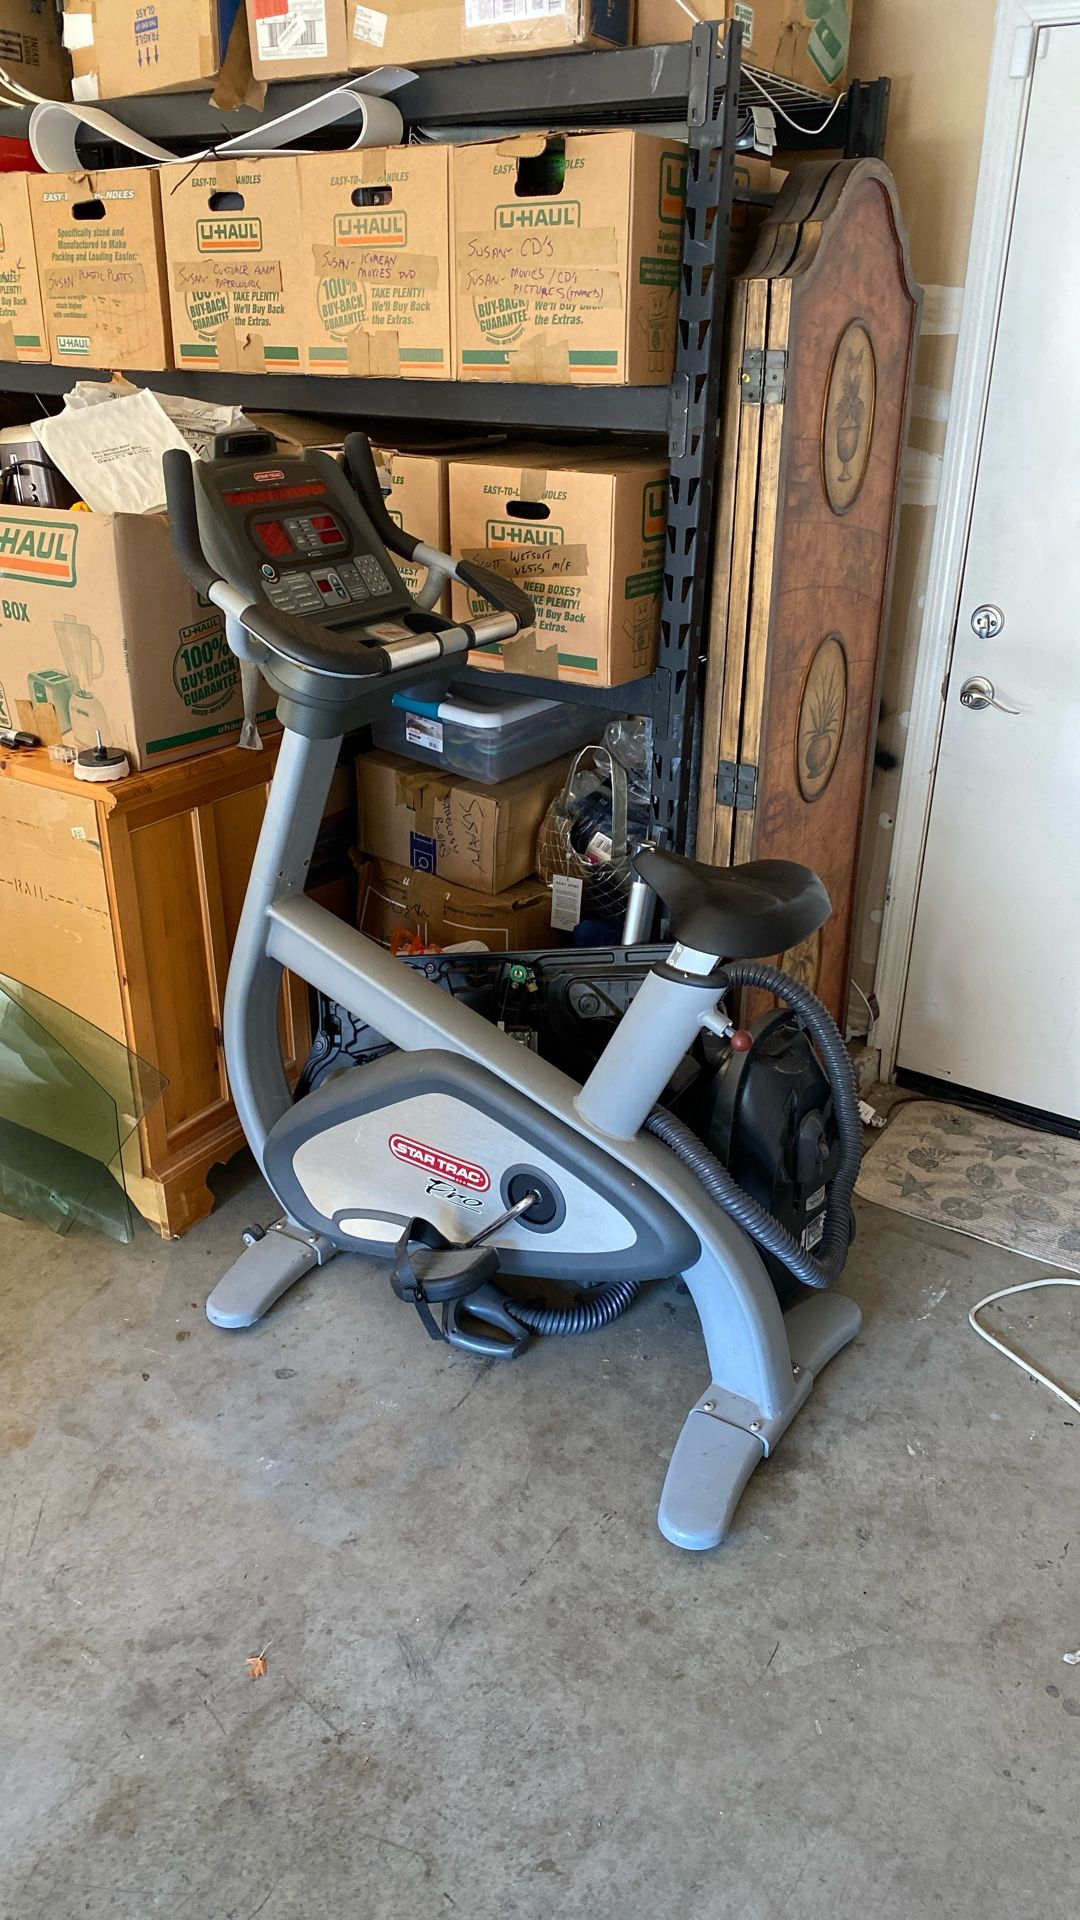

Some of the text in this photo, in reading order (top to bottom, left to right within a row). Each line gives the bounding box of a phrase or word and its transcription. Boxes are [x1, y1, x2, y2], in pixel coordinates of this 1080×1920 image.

[94, 190, 135, 200] HNDLES
[57, 226, 125, 239] Specifically sized and
[108, 239, 127, 249] Make
[51, 251, 75, 262] Packing
[75, 252, 87, 261] and
[88, 251, 113, 262] Loading
[357, 267, 392, 280] MOVIES
[510, 267, 545, 281] MOVIES
[233, 291, 250, 302] TAKE
[251, 291, 281, 302] PLENTY!
[371, 287, 391, 299] TAKE
[392, 287, 425, 298] PLENTY!
[189, 296, 286, 318] BUY-BACK We'll Buy Back
[321, 294, 431, 318] BUY-BACK We'll Buy Back
[534, 300, 557, 311] We'll
[234, 316, 247, 327] the
[247, 316, 272, 327] Extras.
[324, 309, 414, 331] GUARANTEE the Extras.
[480, 309, 584, 333] GUARANTEE the Extras.
[523, 581, 582, 598] NEED BOXES?
[545, 596, 581, 610] PLENTY!
[2, 600, 31, 622] BOX
[545, 609, 563, 622] Buy
[563, 611, 586, 624] Back
[539, 620, 569, 633] Extras.
[181, 634, 230, 672] 100%
[180, 656, 237, 693] BUY-BACK
[183, 673, 239, 707] GUARANTEE
[394, 1142, 481, 1183] STAR TRAC
[425, 1177, 484, 1207] Pro
